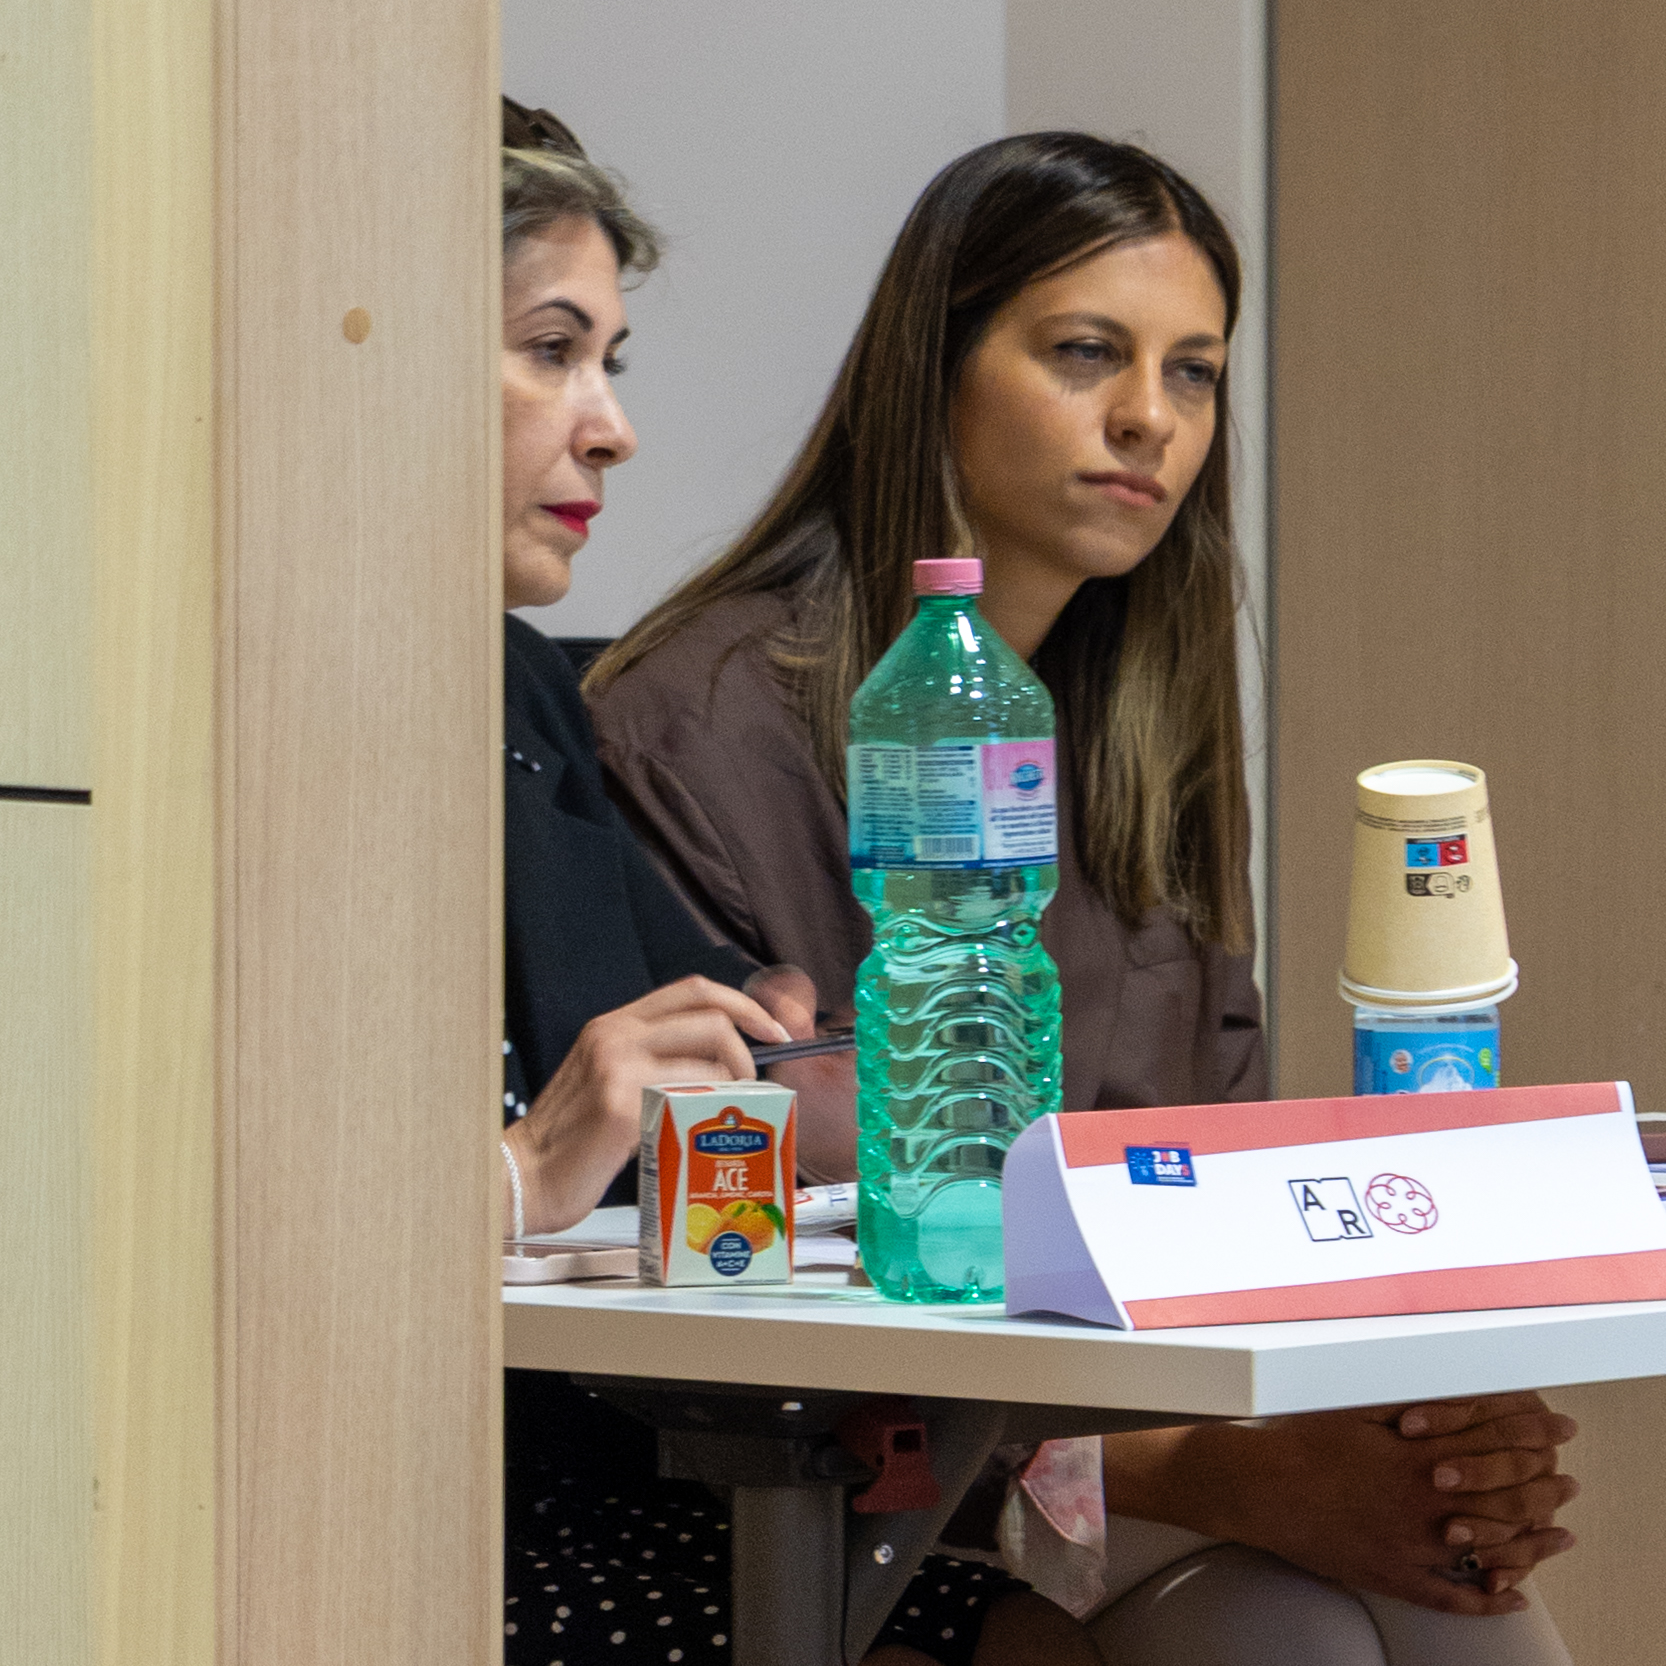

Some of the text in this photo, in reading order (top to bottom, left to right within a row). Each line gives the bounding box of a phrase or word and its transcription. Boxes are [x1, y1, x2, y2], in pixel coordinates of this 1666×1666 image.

[1151, 1150, 1181, 1163] JOB
[712, 1167, 749, 1191] ACE
[1154, 1163, 1191, 1177] DAYS
[1303, 1184, 1326, 1211] A
[1337, 1209, 1366, 1235] R
